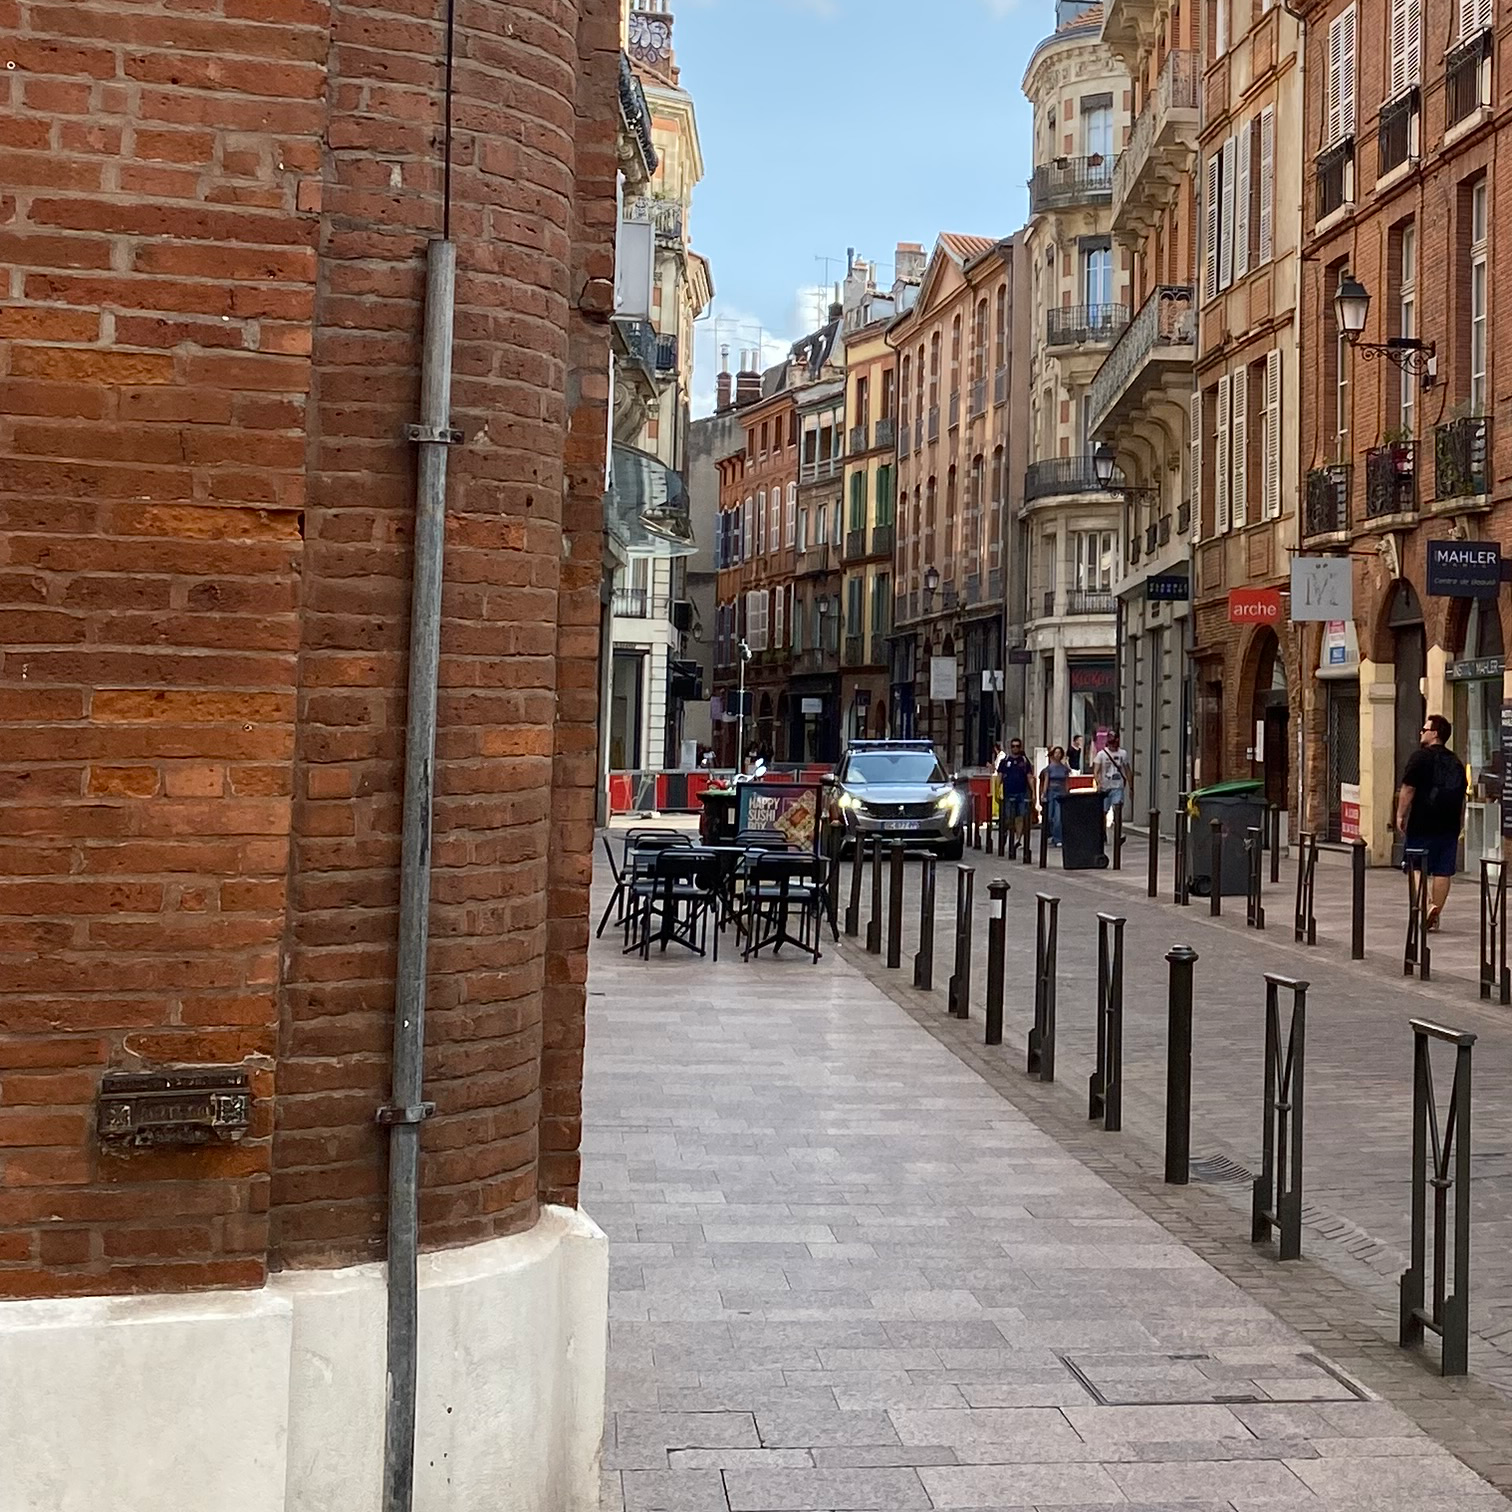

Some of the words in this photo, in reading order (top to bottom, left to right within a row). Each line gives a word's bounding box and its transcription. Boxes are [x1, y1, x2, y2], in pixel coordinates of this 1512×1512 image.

[1437, 550, 1497, 565] MAHLER
[1233, 601, 1277, 616] arche
[748, 796, 780, 810] HAPPY
[747, 809, 776, 822] SUSHI
